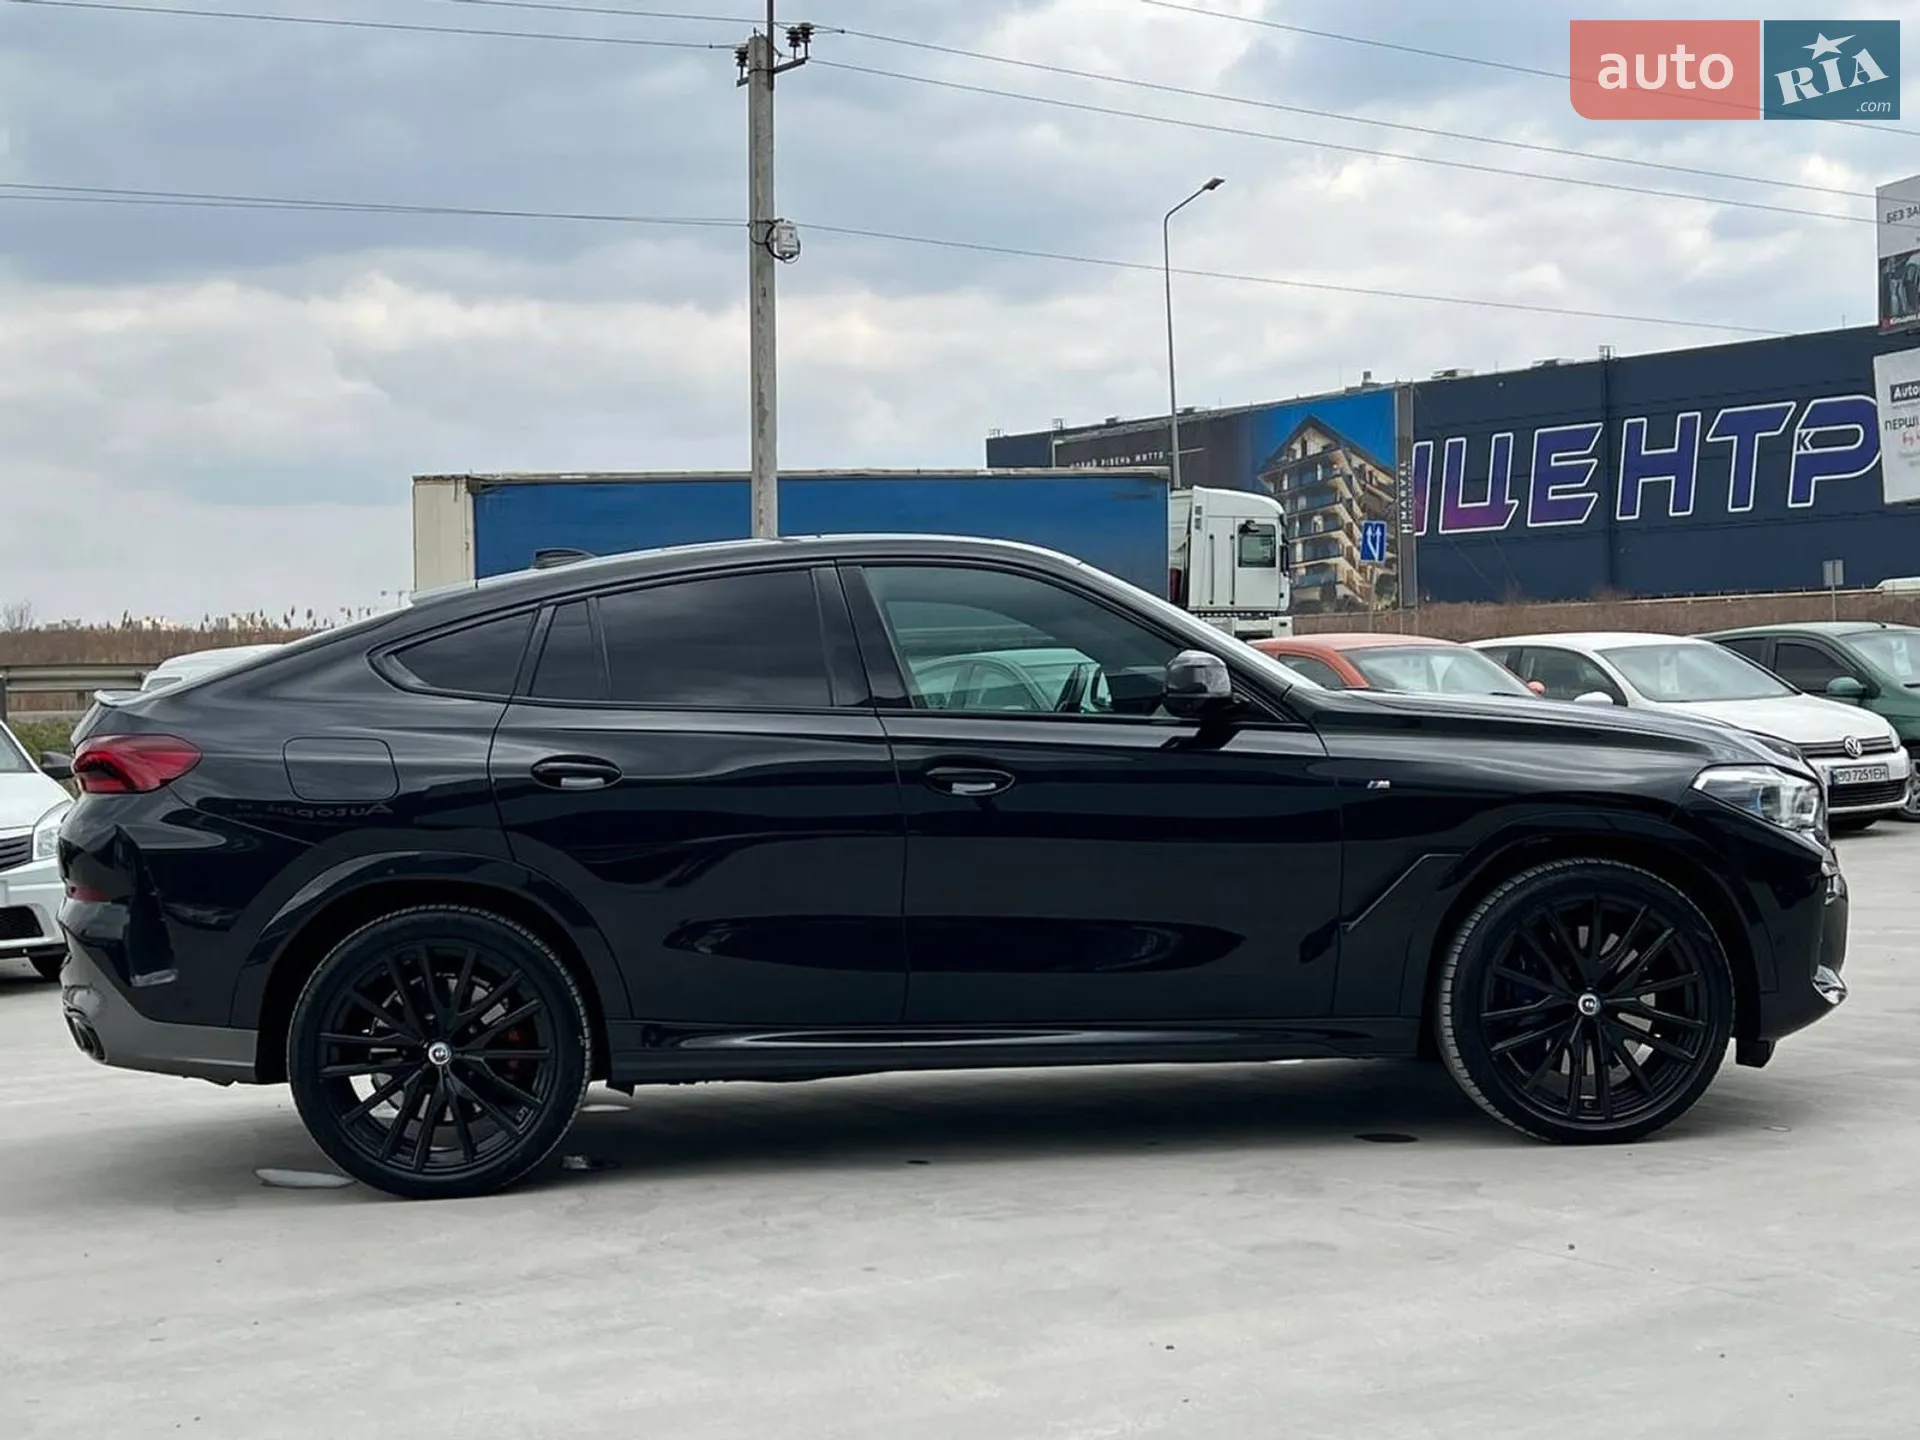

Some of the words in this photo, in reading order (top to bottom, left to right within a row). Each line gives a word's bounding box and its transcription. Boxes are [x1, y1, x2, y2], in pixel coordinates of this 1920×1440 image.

[1886, 209, 1904, 224] БЕЗ
[1906, 204, 1920, 219] ЗА
[1893, 384, 1920, 400] Auto
